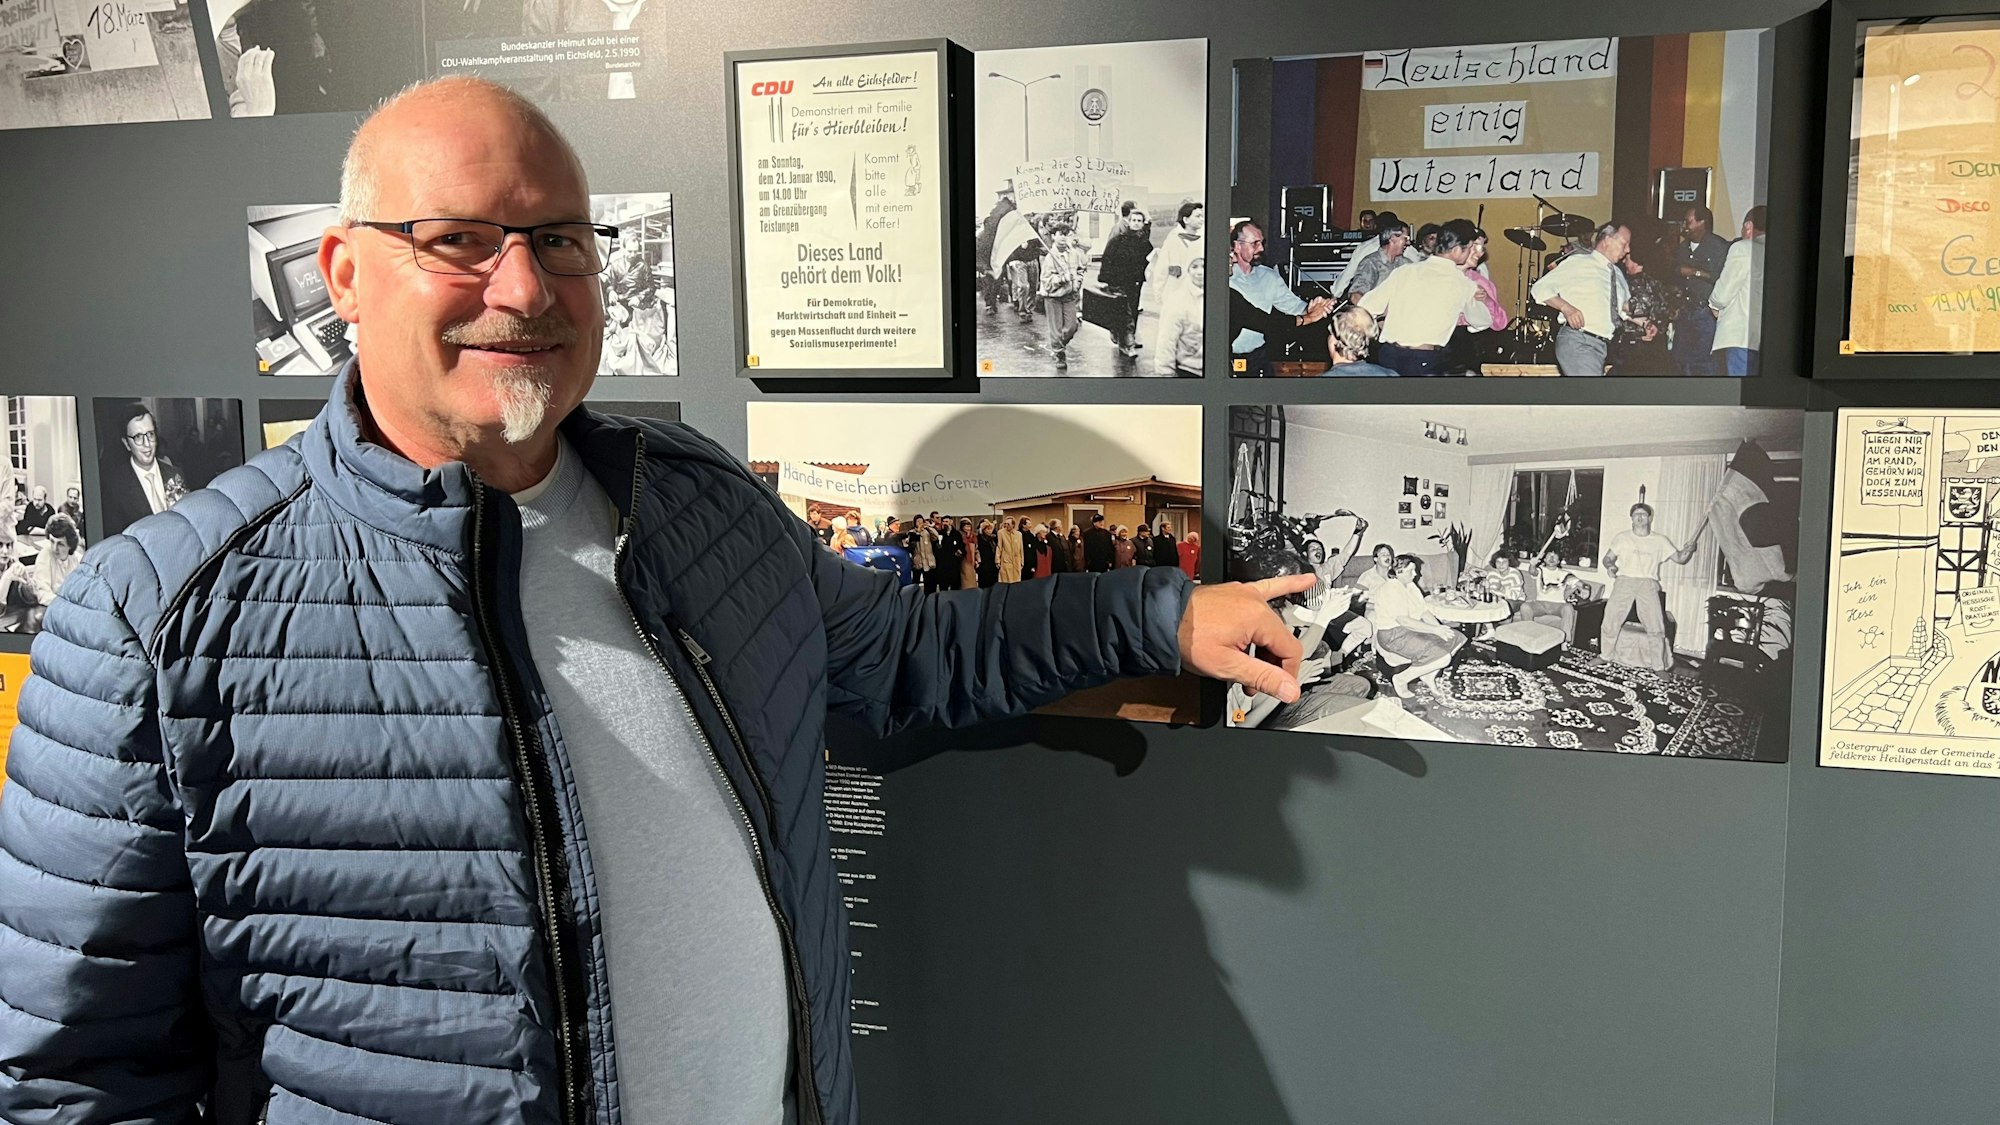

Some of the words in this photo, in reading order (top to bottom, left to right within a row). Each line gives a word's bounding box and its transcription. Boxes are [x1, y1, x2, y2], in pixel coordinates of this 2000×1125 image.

[0, 0, 47, 28] REIHEIT
[501, 40, 555, 52] Bundeskanzler
[557, 38, 585, 48] Helmut
[588, 37, 604, 46] Kohl
[606, 36, 618, 45] bei
[620, 36, 640, 44] einer
[442, 54, 554, 68] CDU-Wahlkampfveranstaltung
[555, 52, 565, 61] im
[567, 50, 603, 60] Eichsfeld,
[605, 48, 640, 58] 2.5.1990
[1375, 37, 1612, 88] Deutschland
[605, 61, 640, 69] Bundesarchiv
[813, 76, 832, 88] An
[836, 74, 854, 87] alle
[857, 71, 918, 88] Eichsfelder!
[751, 80, 794, 96] CDU
[791, 104, 854, 118] Demonstriert
[857, 103, 872, 114] mit
[877, 100, 912, 114] Familie
[823, 117, 907, 136] Hierbleiben!
[1431, 103, 1523, 143] einig
[758, 158, 768, 169] am
[771, 155, 804, 169] Sonntag,
[864, 153, 899, 164] Kommt
[1052, 160, 1068, 169] die
[758, 173, 774, 185] dem
[776, 172, 787, 184] 21.
[789, 170, 813, 185] Januar
[816, 170, 836, 184] 1990,
[865, 169, 886, 181] bitte
[1035, 175, 1051, 184] die
[1058, 171, 1086, 183] Macht
[1377, 152, 1585, 194] Vaterland
[759, 190, 770, 200] um
[772, 188, 791, 200] 14.00
[794, 188, 807, 200] Uhr
[865, 185, 886, 197] alle
[1019, 188, 1048, 200] Gehen
[1052, 186, 1070, 196] wir
[1074, 185, 1096, 198] noch
[759, 206, 770, 217] am
[773, 203, 827, 217] Grenzübergang
[866, 201, 880, 213] mit
[883, 201, 912, 212] einem
[760, 220, 799, 233] Teistungen
[866, 216, 900, 229] Koffer!
[798, 243, 844, 262] Dieses
[849, 241, 883, 261] Land
[1941, 234, 2000, 276] GE
[781, 265, 826, 288] gehört
[831, 265, 861, 284] dem
[866, 264, 902, 283] Volk!
[807, 298, 820, 307] Für
[823, 297, 876, 308] Demokratie,
[777, 311, 846, 320] Marktwirtschaft
[848, 310, 864, 320] und
[866, 310, 896, 319] Einheit
[770, 329, 796, 338] gegen
[798, 326, 854, 336] Massenflucht
[856, 326, 881, 335] durch
[883, 326, 916, 335] weitere
[789, 339, 897, 350] Sozialismusexperimente!
[1868, 436, 1900, 444] LIEGEN
[1905, 436, 1922, 444] WIR
[1894, 446, 1922, 454] GANZ
[1884, 457, 1917, 466] RAND,
[1907, 467, 1922, 476] WIR
[784, 462, 822, 488] Hände
[826, 478, 887, 495] reichen
[891, 478, 930, 493] über
[934, 474, 991, 491] Grenzen
[1867, 478, 1891, 486] DOCH
[1894, 478, 1916, 486] ZUM
[1843, 582, 1862, 594] Ich
[1870, 576, 1888, 587] bin
[1857, 592, 1878, 604] ein
[1828, 750, 1876, 761] feldkreis
[1880, 754, 1951, 766] Heiligenstadt
[1972, 760, 1992, 768] das
[1920, 747, 1938, 755] der
[1941, 748, 1995, 759] Gemeinde
